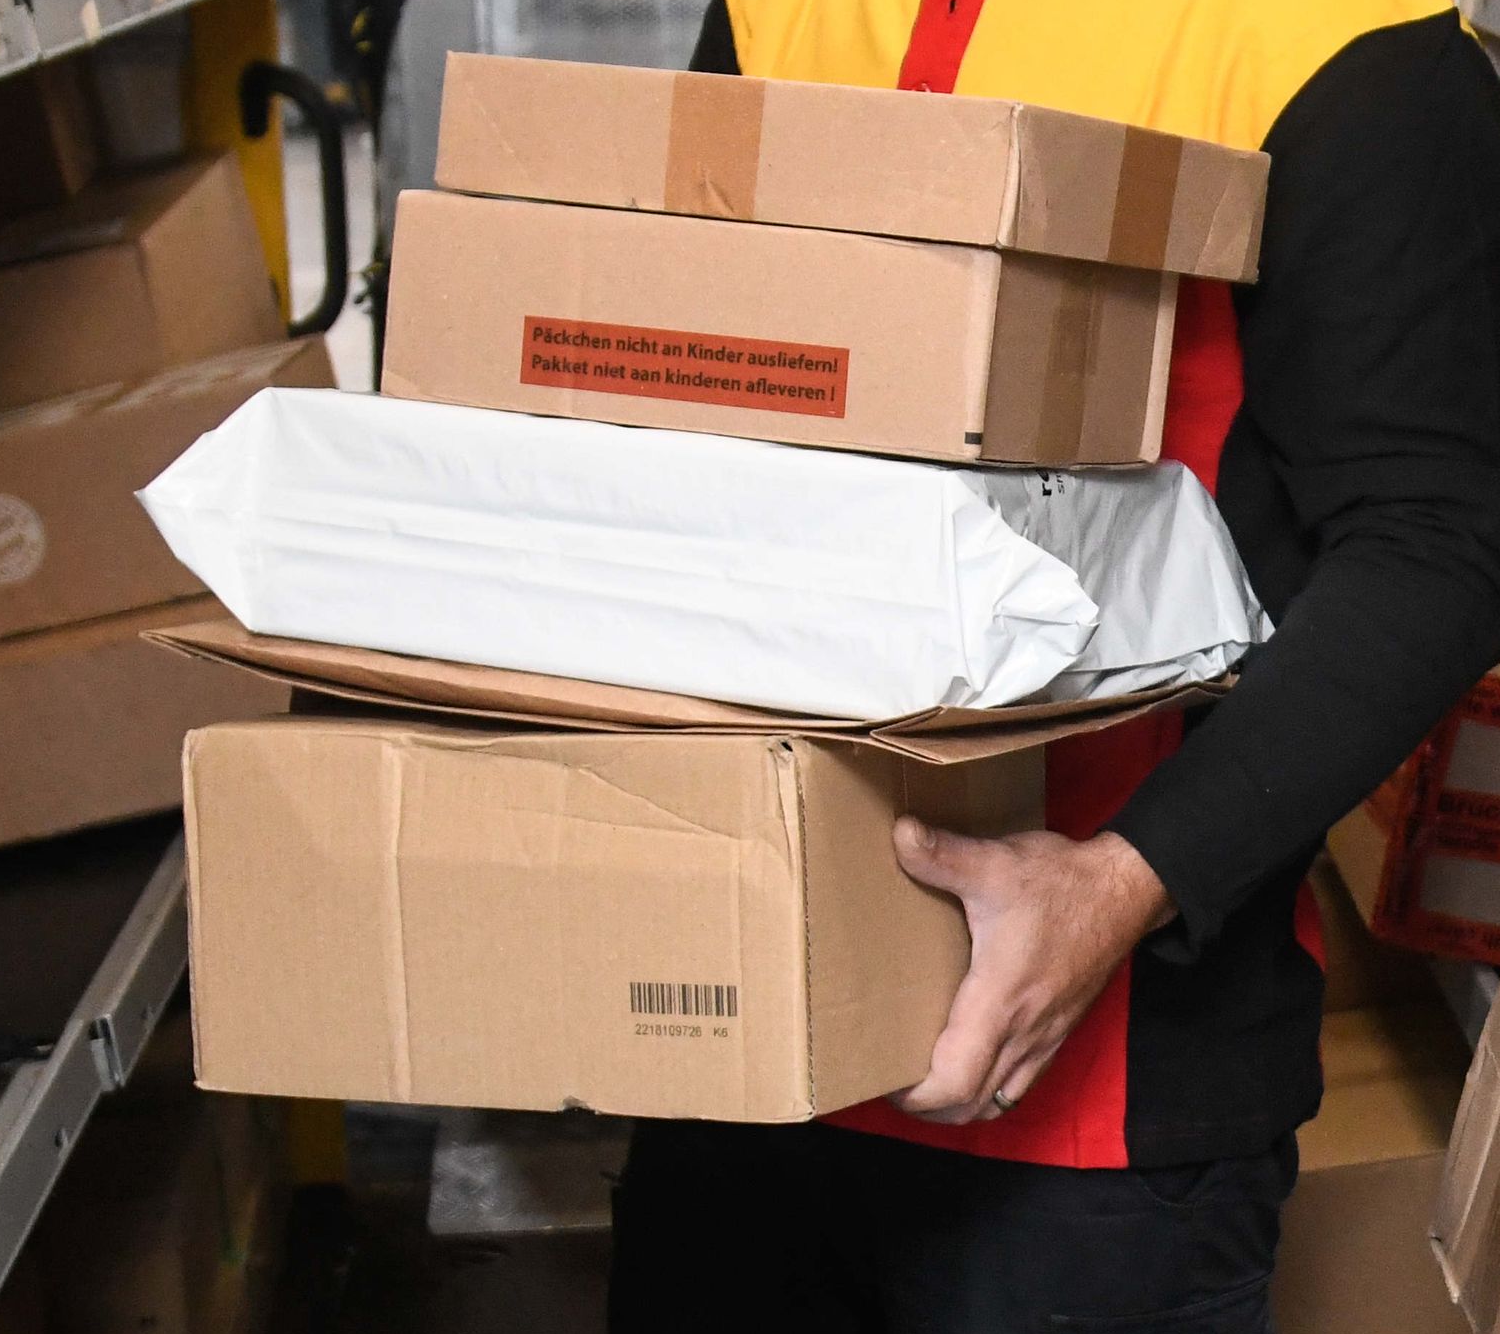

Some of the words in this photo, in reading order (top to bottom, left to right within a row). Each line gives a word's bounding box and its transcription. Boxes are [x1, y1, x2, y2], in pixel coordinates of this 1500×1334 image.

[531, 326, 612, 351] Päckchen
[615, 336, 658, 357] nicht
[661, 343, 682, 357] an
[687, 343, 745, 364] Kinder
[747, 351, 839, 374] ausliefern!
[531, 354, 589, 376] Pakket
[593, 360, 626, 380] niet
[630, 367, 661, 384] aan
[665, 369, 741, 393] kinderen
[745, 377, 827, 402] afleveren
